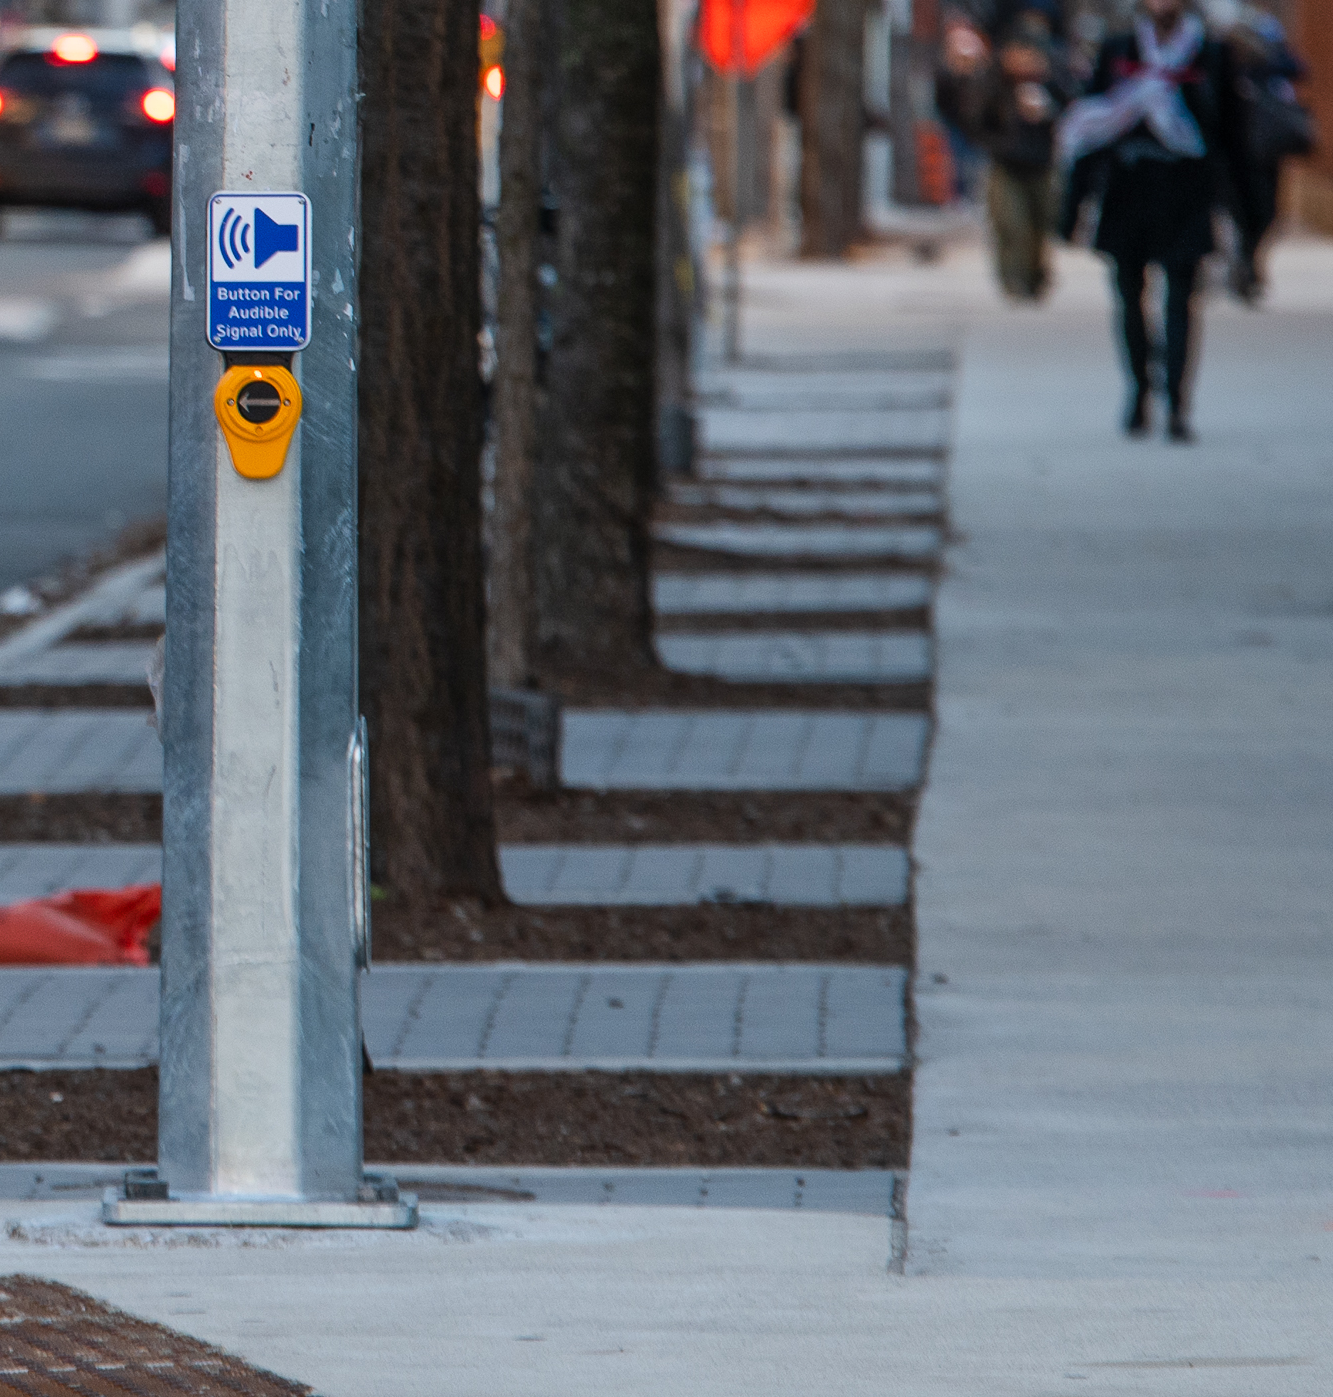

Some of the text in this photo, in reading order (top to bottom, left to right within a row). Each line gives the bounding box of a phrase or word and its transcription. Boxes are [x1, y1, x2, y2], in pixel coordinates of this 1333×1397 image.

[217, 287, 301, 301] Button For
[228, 306, 289, 319] Audible
[216, 324, 302, 341] Signal Only
